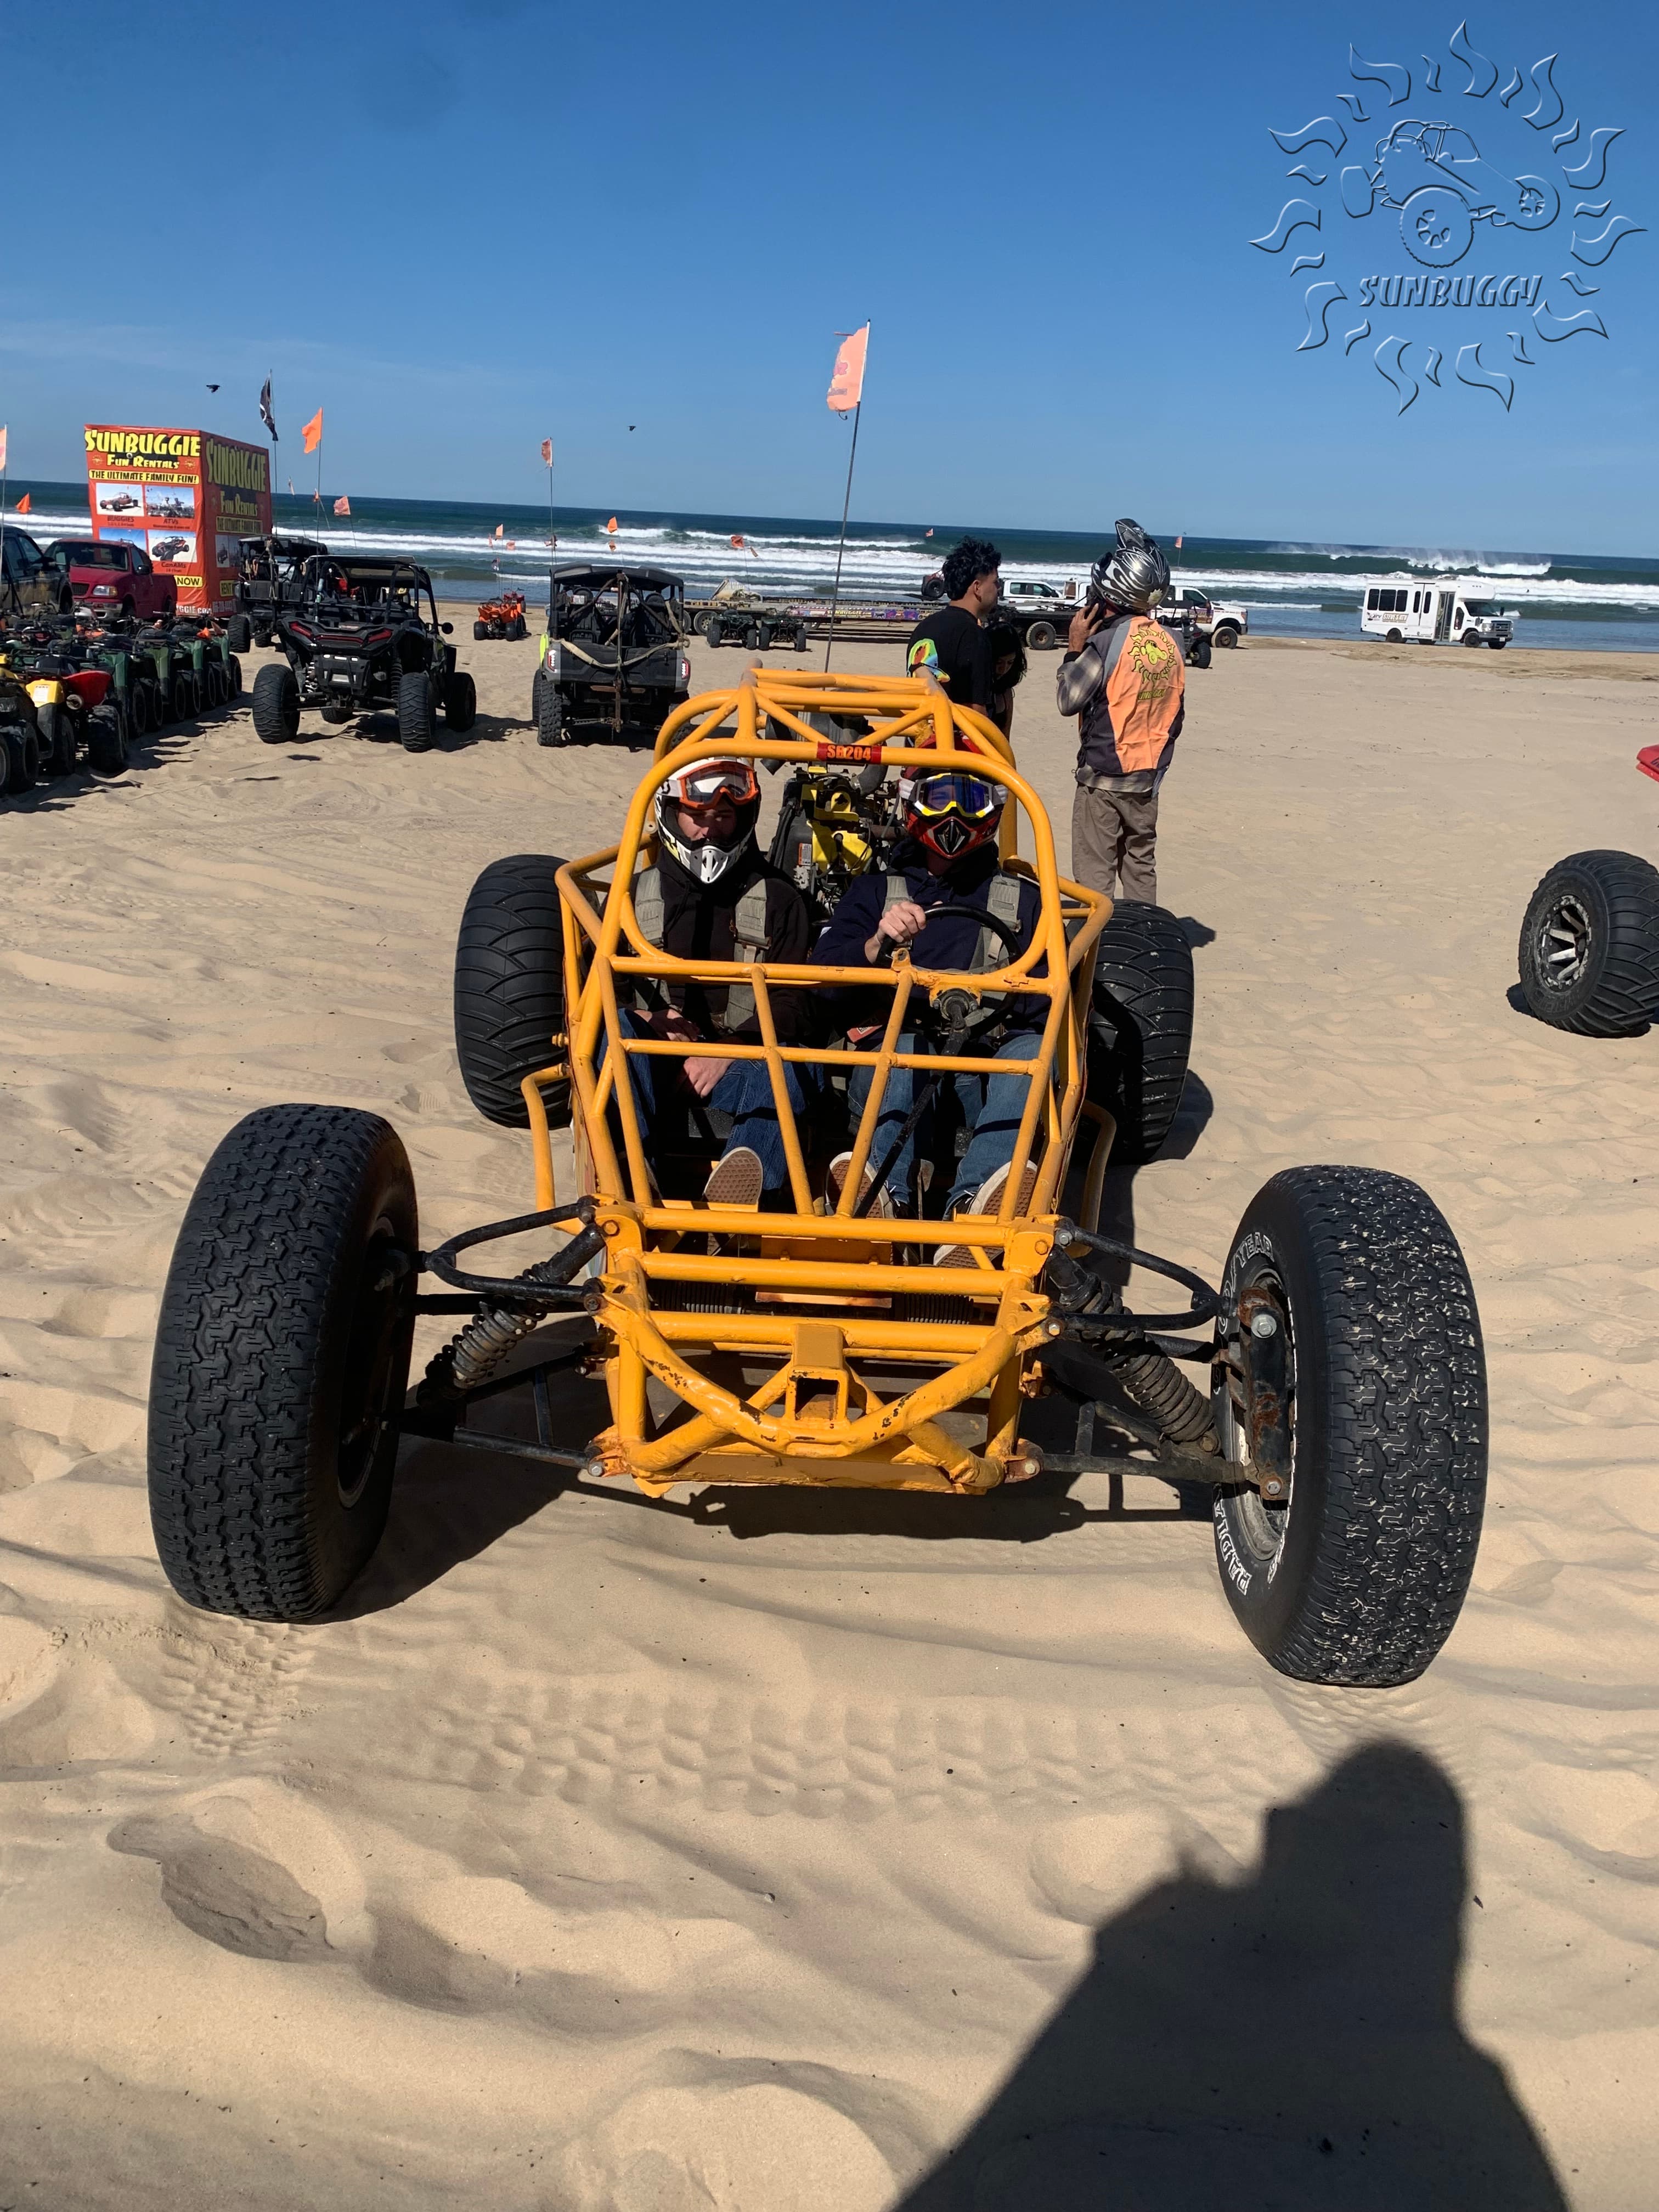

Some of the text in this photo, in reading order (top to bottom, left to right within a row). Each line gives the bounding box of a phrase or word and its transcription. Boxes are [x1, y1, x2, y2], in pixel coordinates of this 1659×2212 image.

[84, 429, 201, 456] SUNBUGGIE
[206, 438, 266, 492] SUNBUGGIE
[92, 470, 197, 483] THE ULTIMATE FAMILY FUN!
[177, 577, 200, 585] NOW
